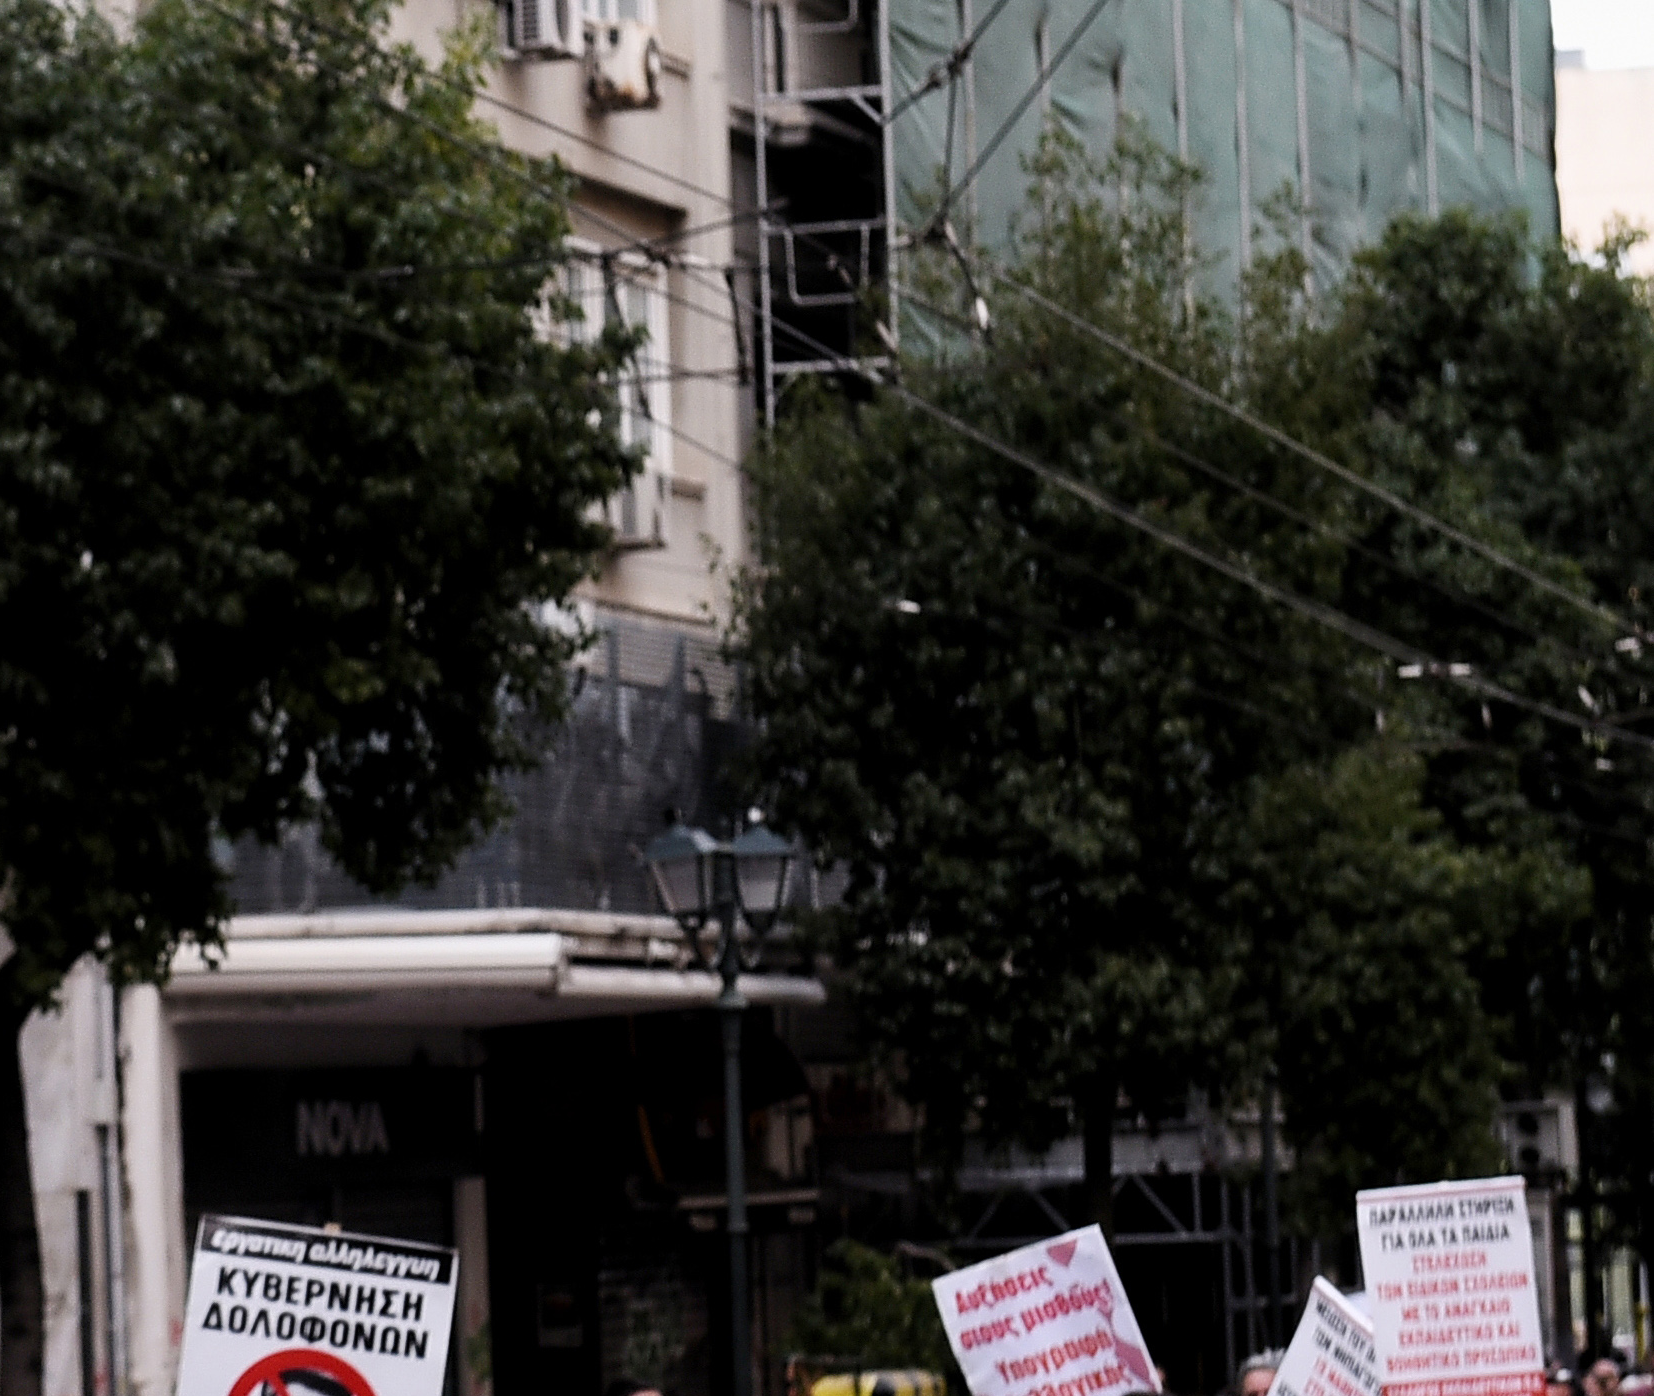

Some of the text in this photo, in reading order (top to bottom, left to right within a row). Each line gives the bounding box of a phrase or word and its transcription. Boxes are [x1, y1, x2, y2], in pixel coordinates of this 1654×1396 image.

[296, 1100, 391, 1156] NOVA
[1369, 1201, 1454, 1229] ΠΑΡΑΛΛΗΛΗ
[1381, 1223, 1511, 1251] ΓΙΑ ΟΛΑ ΤΑ ΠΑΙΔΙΑ
[216, 1266, 425, 1323] ΚΥΒΕΡΝΗΣΗ
[202, 1301, 429, 1359] ΔΟΛΟΦΟΝΩΝ
